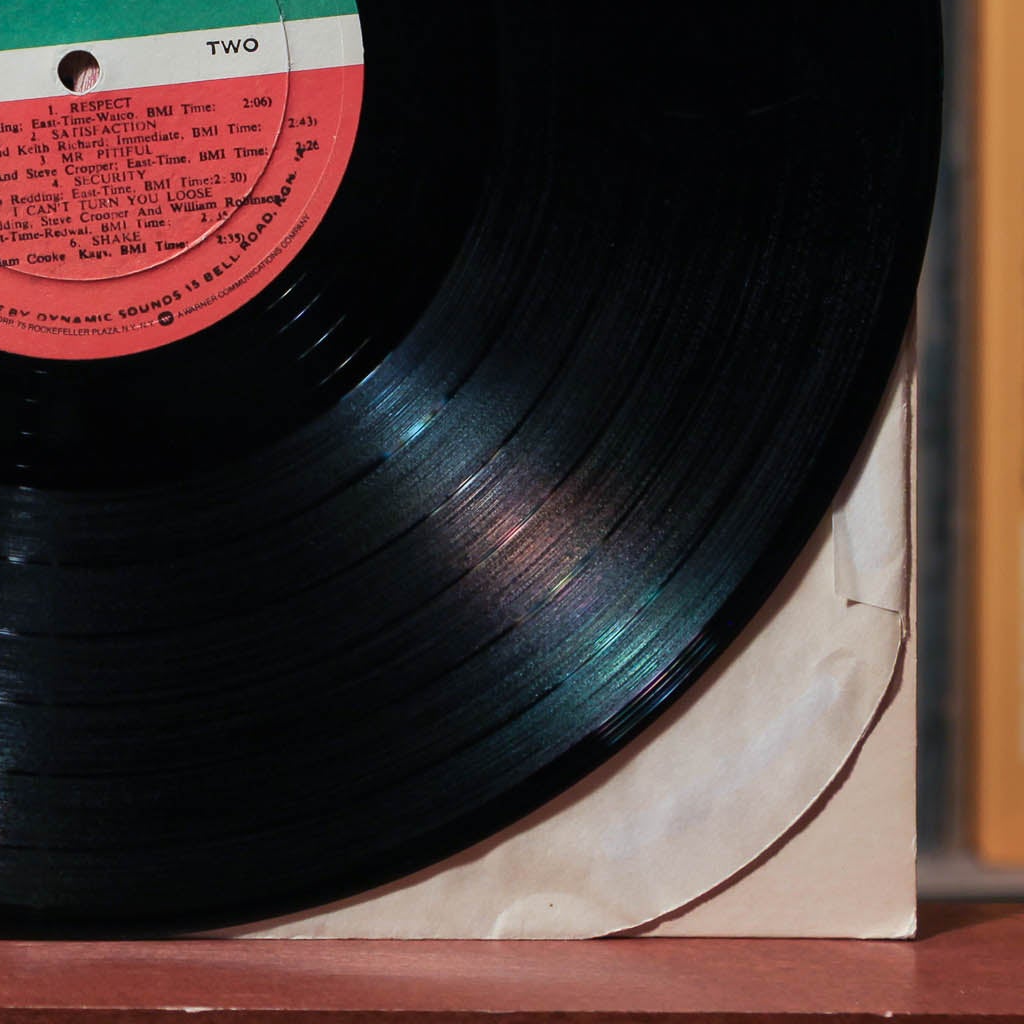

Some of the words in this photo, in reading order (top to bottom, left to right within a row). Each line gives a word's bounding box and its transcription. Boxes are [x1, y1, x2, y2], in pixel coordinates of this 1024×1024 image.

[206, 38, 259, 55] TWO
[70, 97, 132, 113] RESPECT
[147, 105, 174, 118] BMI
[181, 103, 216, 115] Time:
[242, 96, 273, 109] 2:06)
[17, 143, 50, 156] Keith
[192, 125, 218, 138] BMI
[227, 122, 262, 135] Time:
[287, 116, 318, 128] 2:43)
[52, 121, 157, 140] SATISFACTION
[26, 167, 57, 179] Steve
[199, 149, 226, 162] BMI
[233, 147, 269, 159] Time:
[61, 153, 83, 164] MR
[97, 145, 152, 160] PITIFUL
[74, 169, 146, 187] SECURITY
[144, 179, 171, 192] BMI
[26, 201, 69, 217] CAN'T
[79, 197, 119, 211] TURN
[127, 193, 159, 206] YOU
[167, 188, 213, 202] LOOSE
[40, 215, 72, 227] Steve
[138, 207, 162, 217] And
[170, 201, 217, 214] William
[101, 221, 127, 234] BMI
[92, 231, 141, 247] SHAKE
[27, 252, 66, 264] Cooke
[120, 243, 147, 255] BMI
[155, 240, 190, 252] Time:
[183, 295, 218, 316] WARNER
[217, 246, 282, 299] COMMUNICATIONS
[280, 213, 311, 249] COMPANY
[8, 307, 31, 317] BY
[36, 311, 114, 324] DYNAMIC
[118, 290, 182, 318] SOUNDS
[203, 253, 241, 283] BELL
[27, 323, 90, 336] ROCKEFELLER
